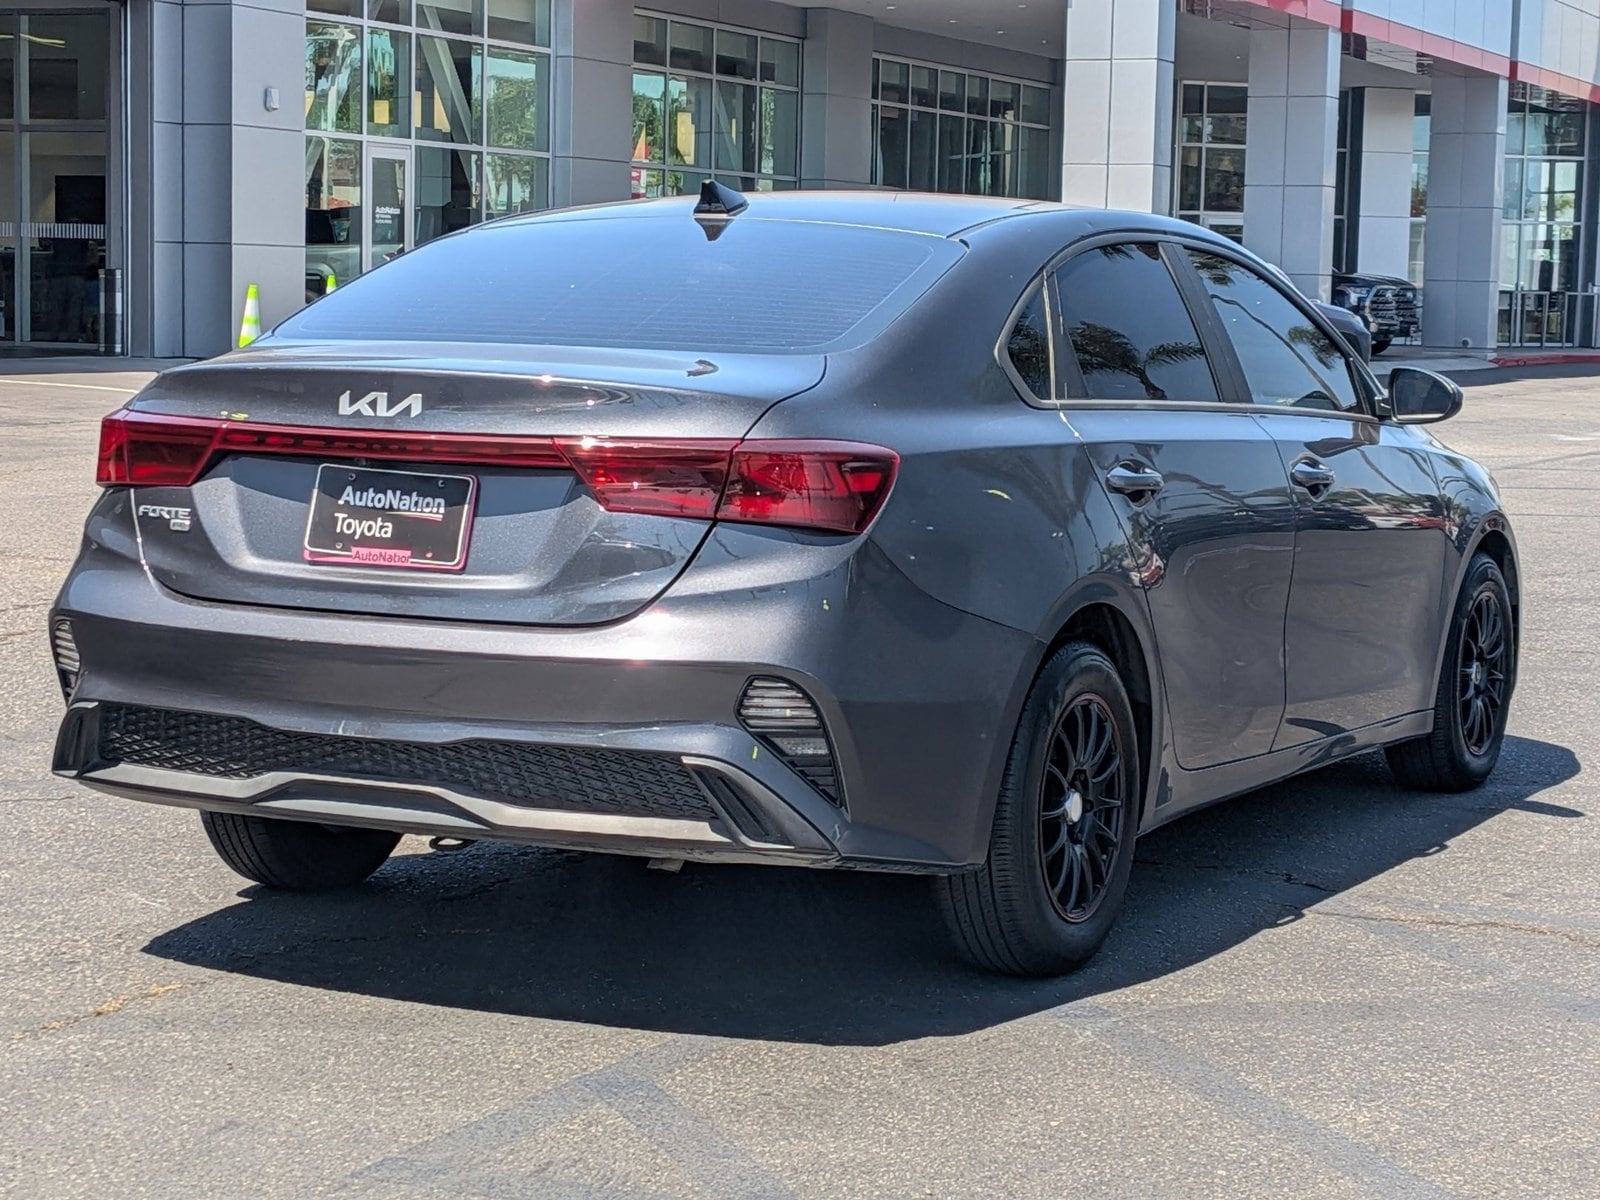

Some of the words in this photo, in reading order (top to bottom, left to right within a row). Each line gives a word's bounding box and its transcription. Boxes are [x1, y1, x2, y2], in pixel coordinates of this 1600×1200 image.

[338, 390, 423, 418] KIA
[138, 505, 191, 519] FORTE
[338, 485, 445, 513] AutoNation
[334, 513, 393, 540] Toyota
